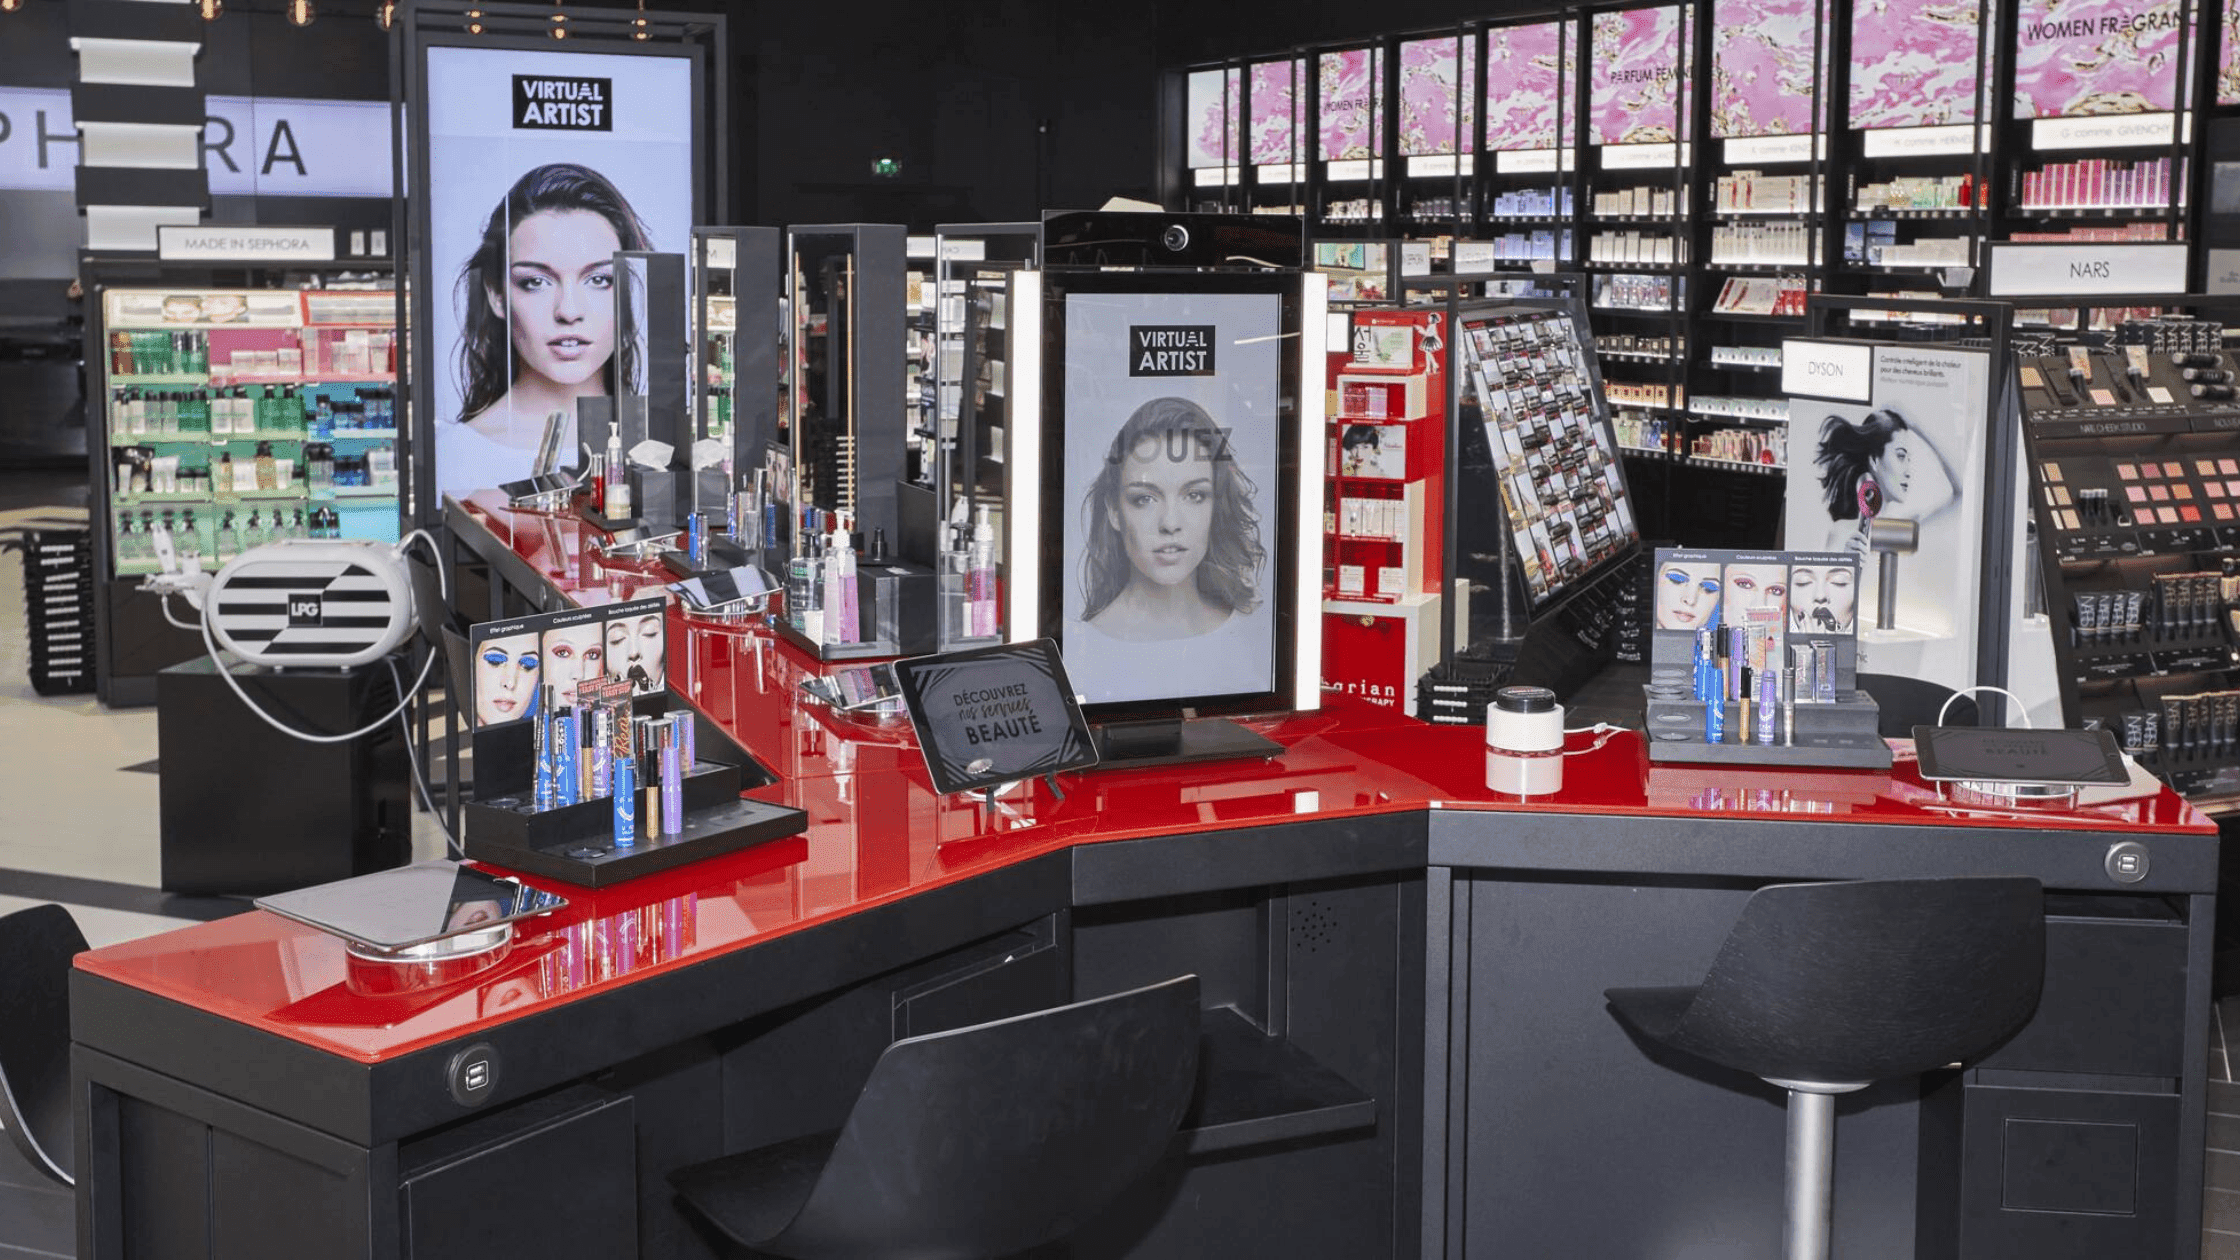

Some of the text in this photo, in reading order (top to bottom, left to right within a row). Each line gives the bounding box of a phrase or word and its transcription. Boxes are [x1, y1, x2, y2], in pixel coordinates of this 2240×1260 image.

[2027, 19, 2095, 40] WOMEN
[522, 80, 603, 101] VIRTUAL
[523, 102, 603, 126] ARTIST
[185, 238, 309, 250] MADE IN SEPHORA
[2070, 261, 2110, 278] NARS
[1139, 331, 1207, 347] VIRTUAL
[1138, 350, 1207, 371] ARTIST
[1808, 361, 1844, 377] DYSON
[1108, 428, 1232, 465] JOUEZ
[291, 602, 319, 617] LPG
[953, 683, 1028, 707] DÉCOUVREZ
[965, 710, 1043, 745] BEAUTÉ
